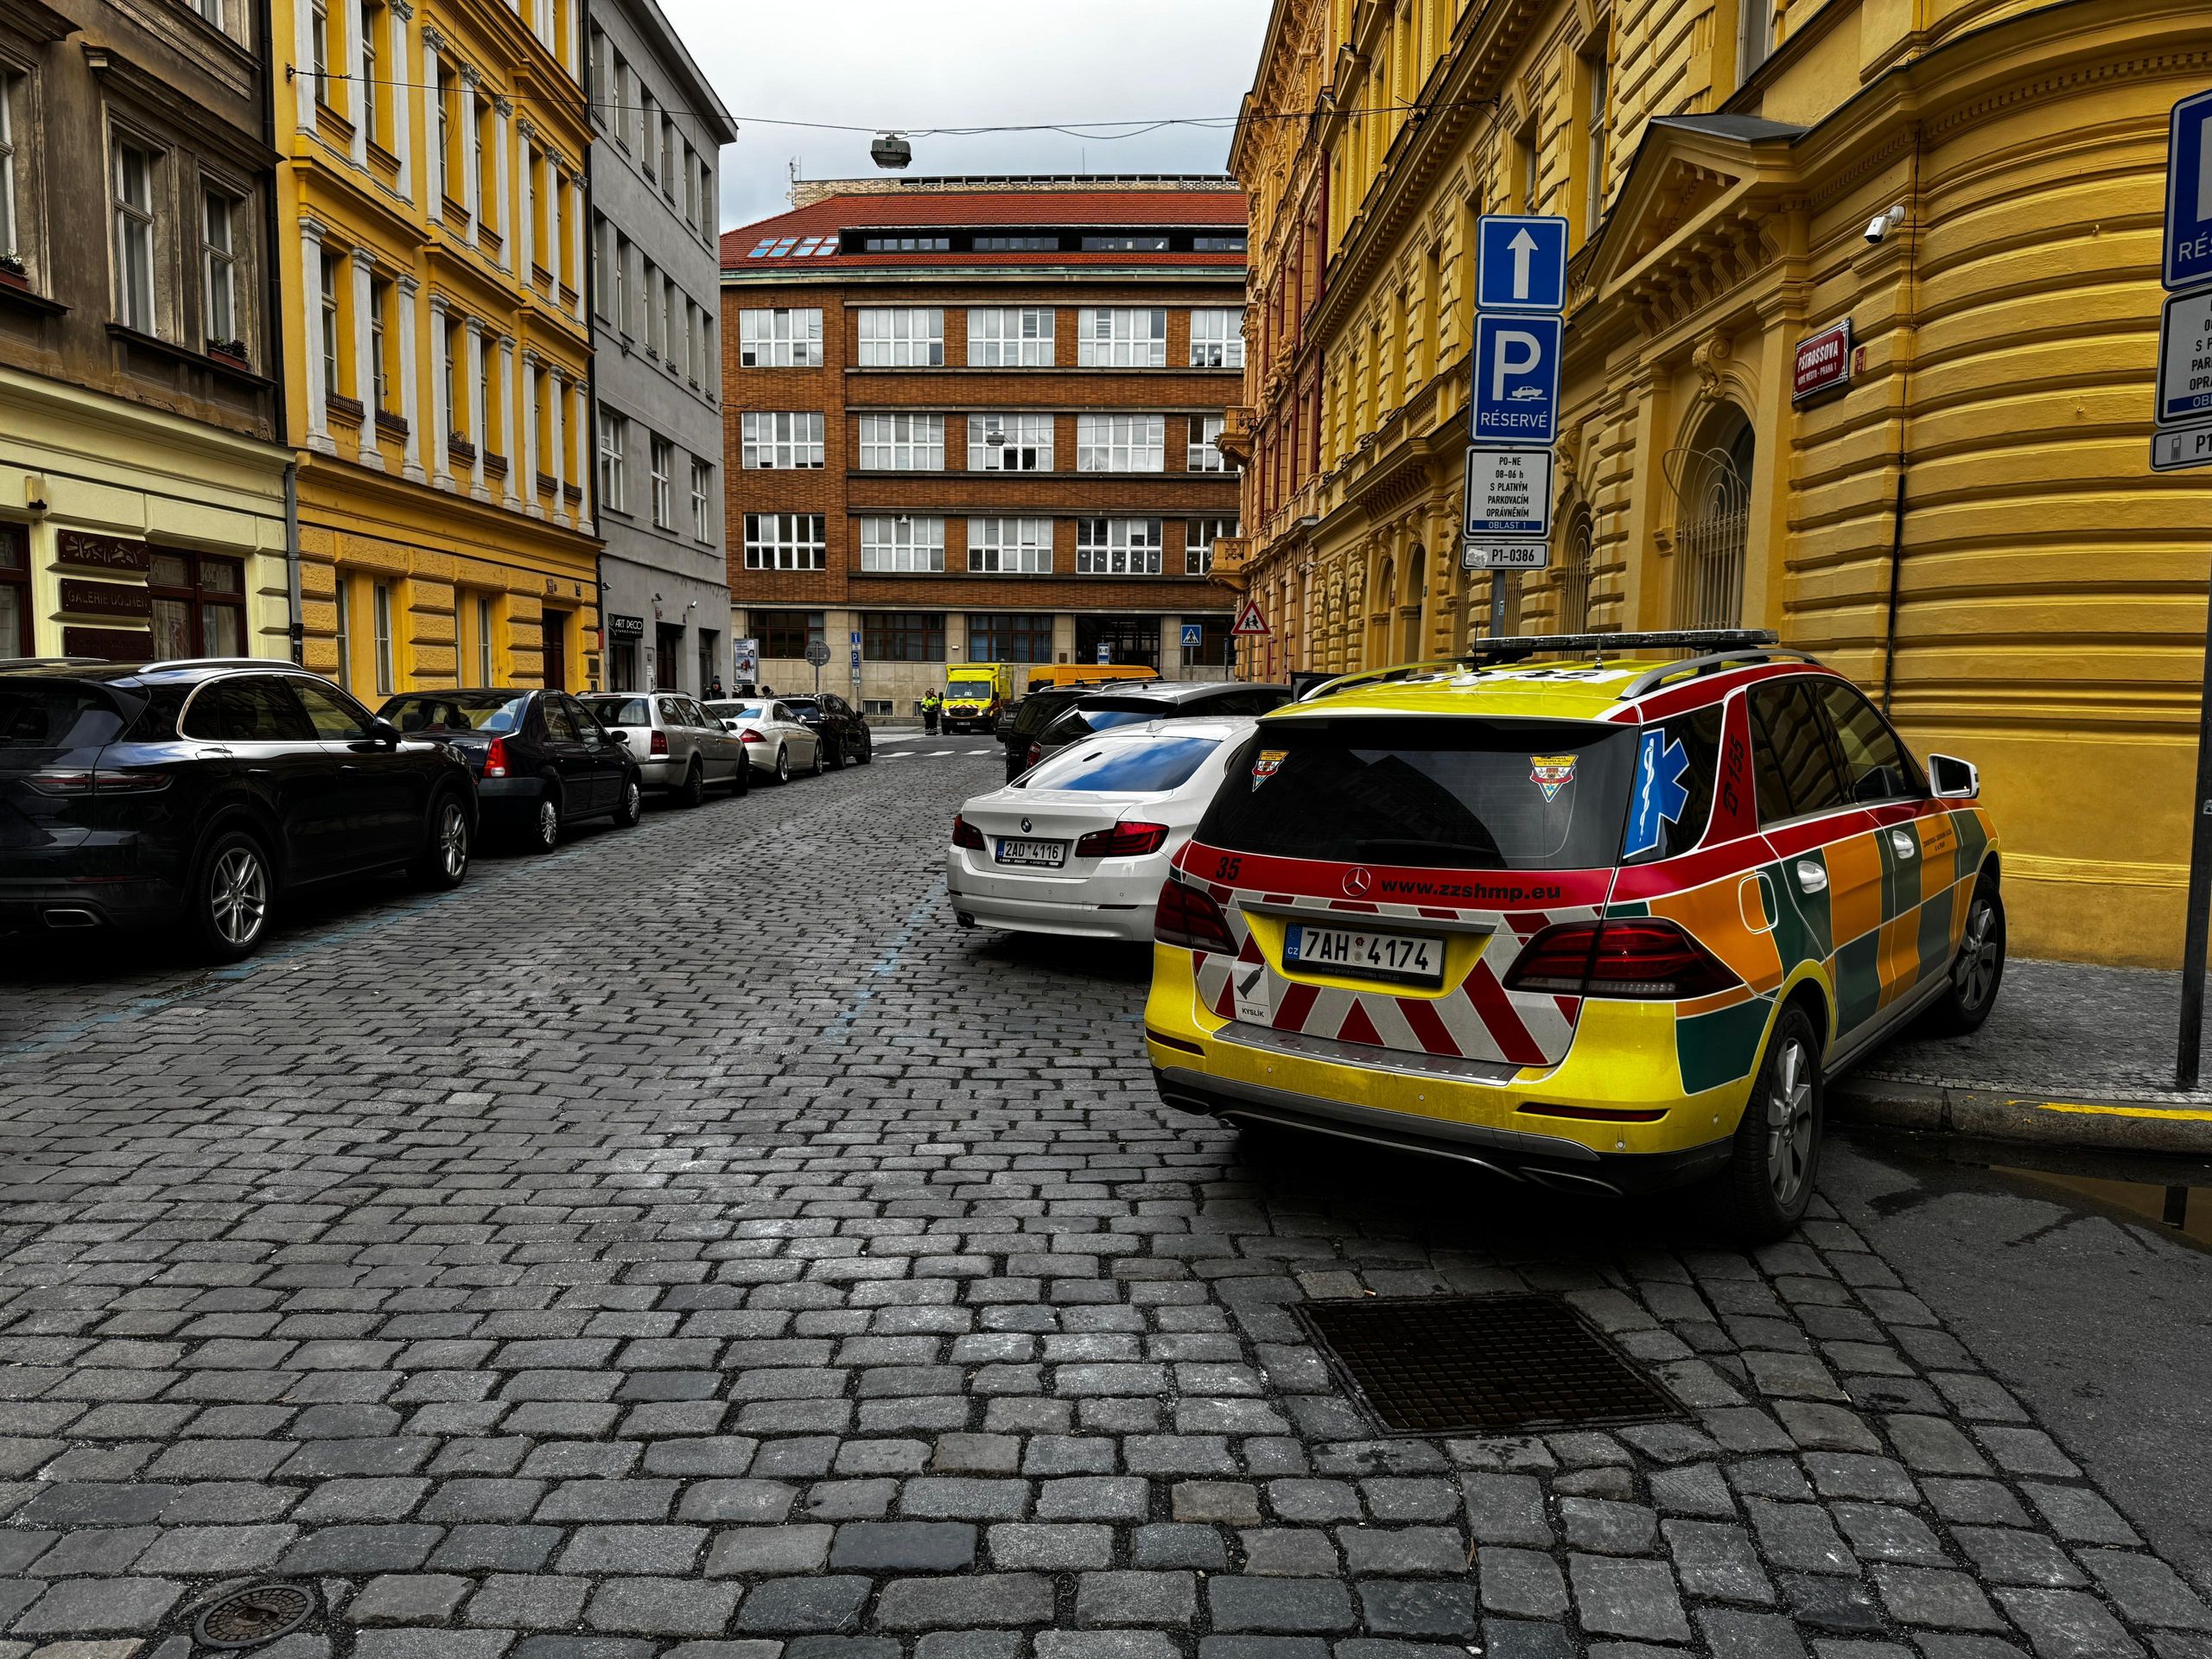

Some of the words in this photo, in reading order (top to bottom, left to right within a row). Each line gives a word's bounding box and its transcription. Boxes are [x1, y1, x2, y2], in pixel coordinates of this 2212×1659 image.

[2177, 231, 2212, 263] RÉ
[2196, 339, 2202, 353] S
[1797, 340, 1839, 373] PŠTROSSOVA
[2191, 355, 2212, 372] PAR
[1491, 329, 1541, 402] P
[1820, 363, 1834, 377] PRAHA
[1480, 409, 1548, 428] RÉSERVÉ
[1498, 456, 1522, 466] PO-NE
[1495, 469, 1516, 479] 08-06
[1519, 470, 1523, 479] h
[1490, 482, 1495, 492] S
[1497, 481, 1528, 492] PLATNÝM
[1487, 493, 1529, 505] PARKOVACÍM
[1486, 506, 1529, 518] OPRÁVNĚNÍM
[1491, 549, 1535, 563] P1-0386
[67, 590, 108, 605] GALERIE
[111, 594, 148, 608] DOLMEN
[615, 619, 626, 628] ART
[626, 620, 643, 630] DECO
[1005, 842, 1026, 857] 2AD
[1032, 843, 1059, 860] 4116
[1216, 856, 1243, 880] 35
[1382, 880, 1560, 902] www.zzshmp.eu
[1287, 945, 1299, 956] CZ
[1305, 931, 1350, 962] 7AH
[1367, 937, 1428, 970] 4174
[1241, 1007, 1265, 1018] KYSLÍK
